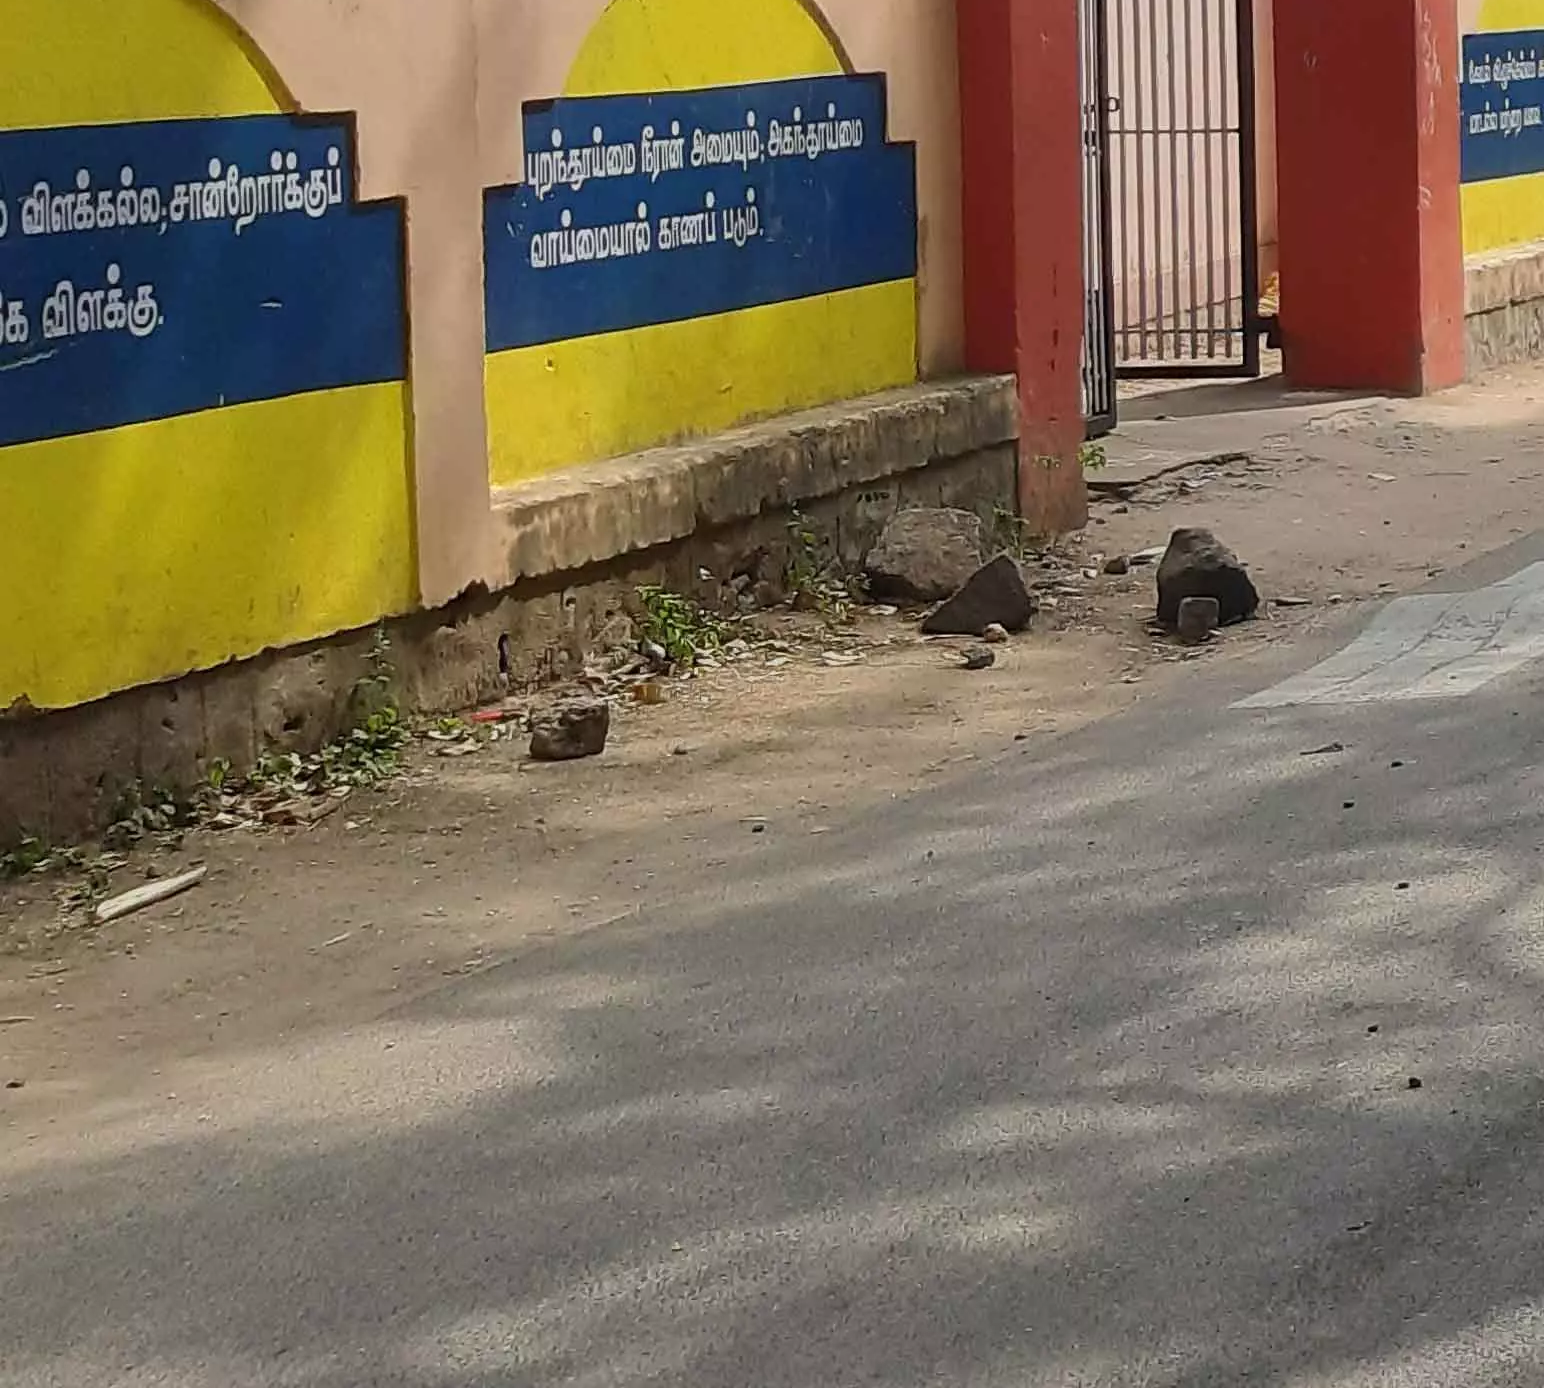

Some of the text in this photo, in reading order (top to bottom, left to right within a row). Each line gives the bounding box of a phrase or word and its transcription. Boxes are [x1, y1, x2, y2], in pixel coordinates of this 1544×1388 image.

[527, 127, 635, 200] புறந்தூய்மை
[641, 120, 685, 183] நீரான்
[767, 103, 864, 160] அகந்தூய்மை
[531, 201, 651, 269] வாய்மையால்
[657, 191, 716, 250] காணப்
